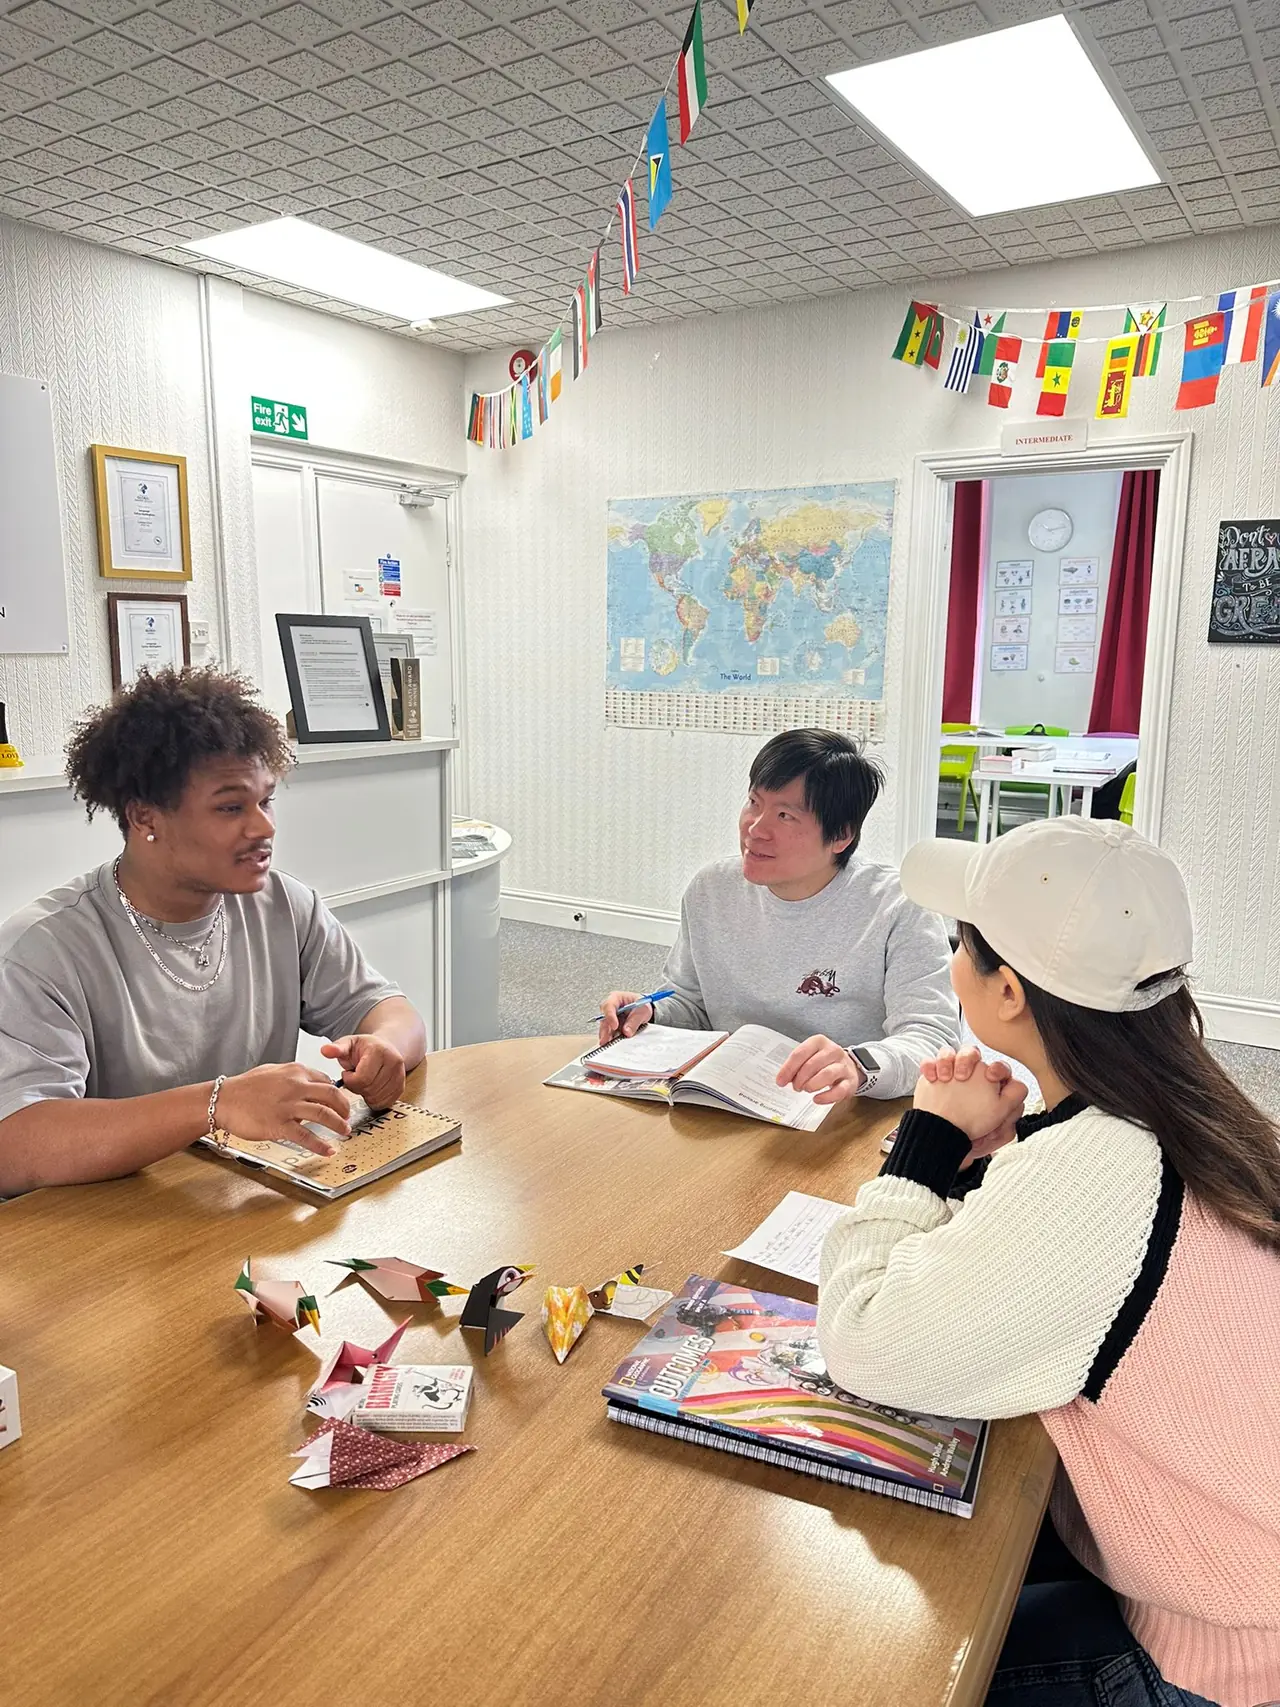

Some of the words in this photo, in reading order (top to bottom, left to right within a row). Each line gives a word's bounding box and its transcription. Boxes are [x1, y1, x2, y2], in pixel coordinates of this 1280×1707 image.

[253, 402, 272, 416] Fire
[254, 416, 273, 428] exit
[1015, 434, 1074, 446] INTERMEDIATE
[1259, 577, 1273, 590] BE
[649, 1334, 714, 1400] OUTCOMES
[365, 1365, 399, 1409] BANKSY
[711, 1422, 758, 1441] INTERMEDIATE
[927, 1457, 940, 1474] Hugh
[940, 1455, 953, 1477] Andrew
